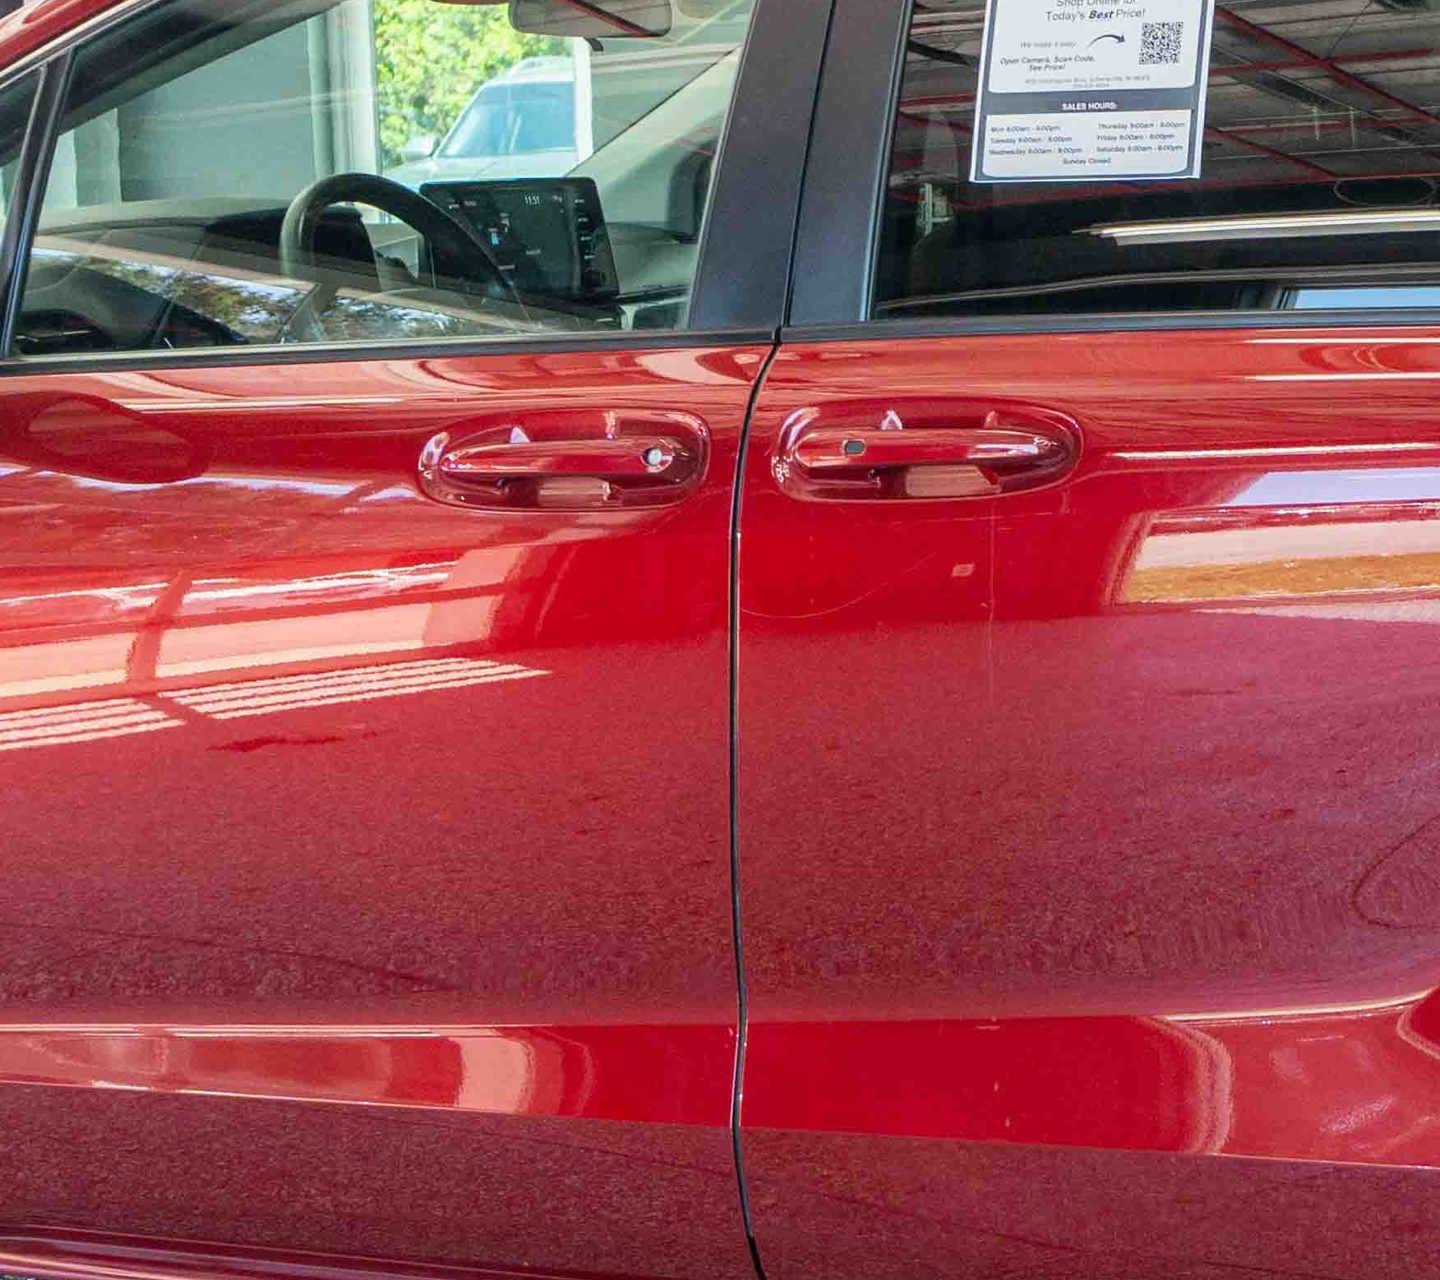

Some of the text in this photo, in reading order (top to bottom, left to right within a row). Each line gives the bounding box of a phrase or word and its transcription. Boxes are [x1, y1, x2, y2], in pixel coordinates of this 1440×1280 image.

[1044, 7, 1146, 22] Today's Best Price!
